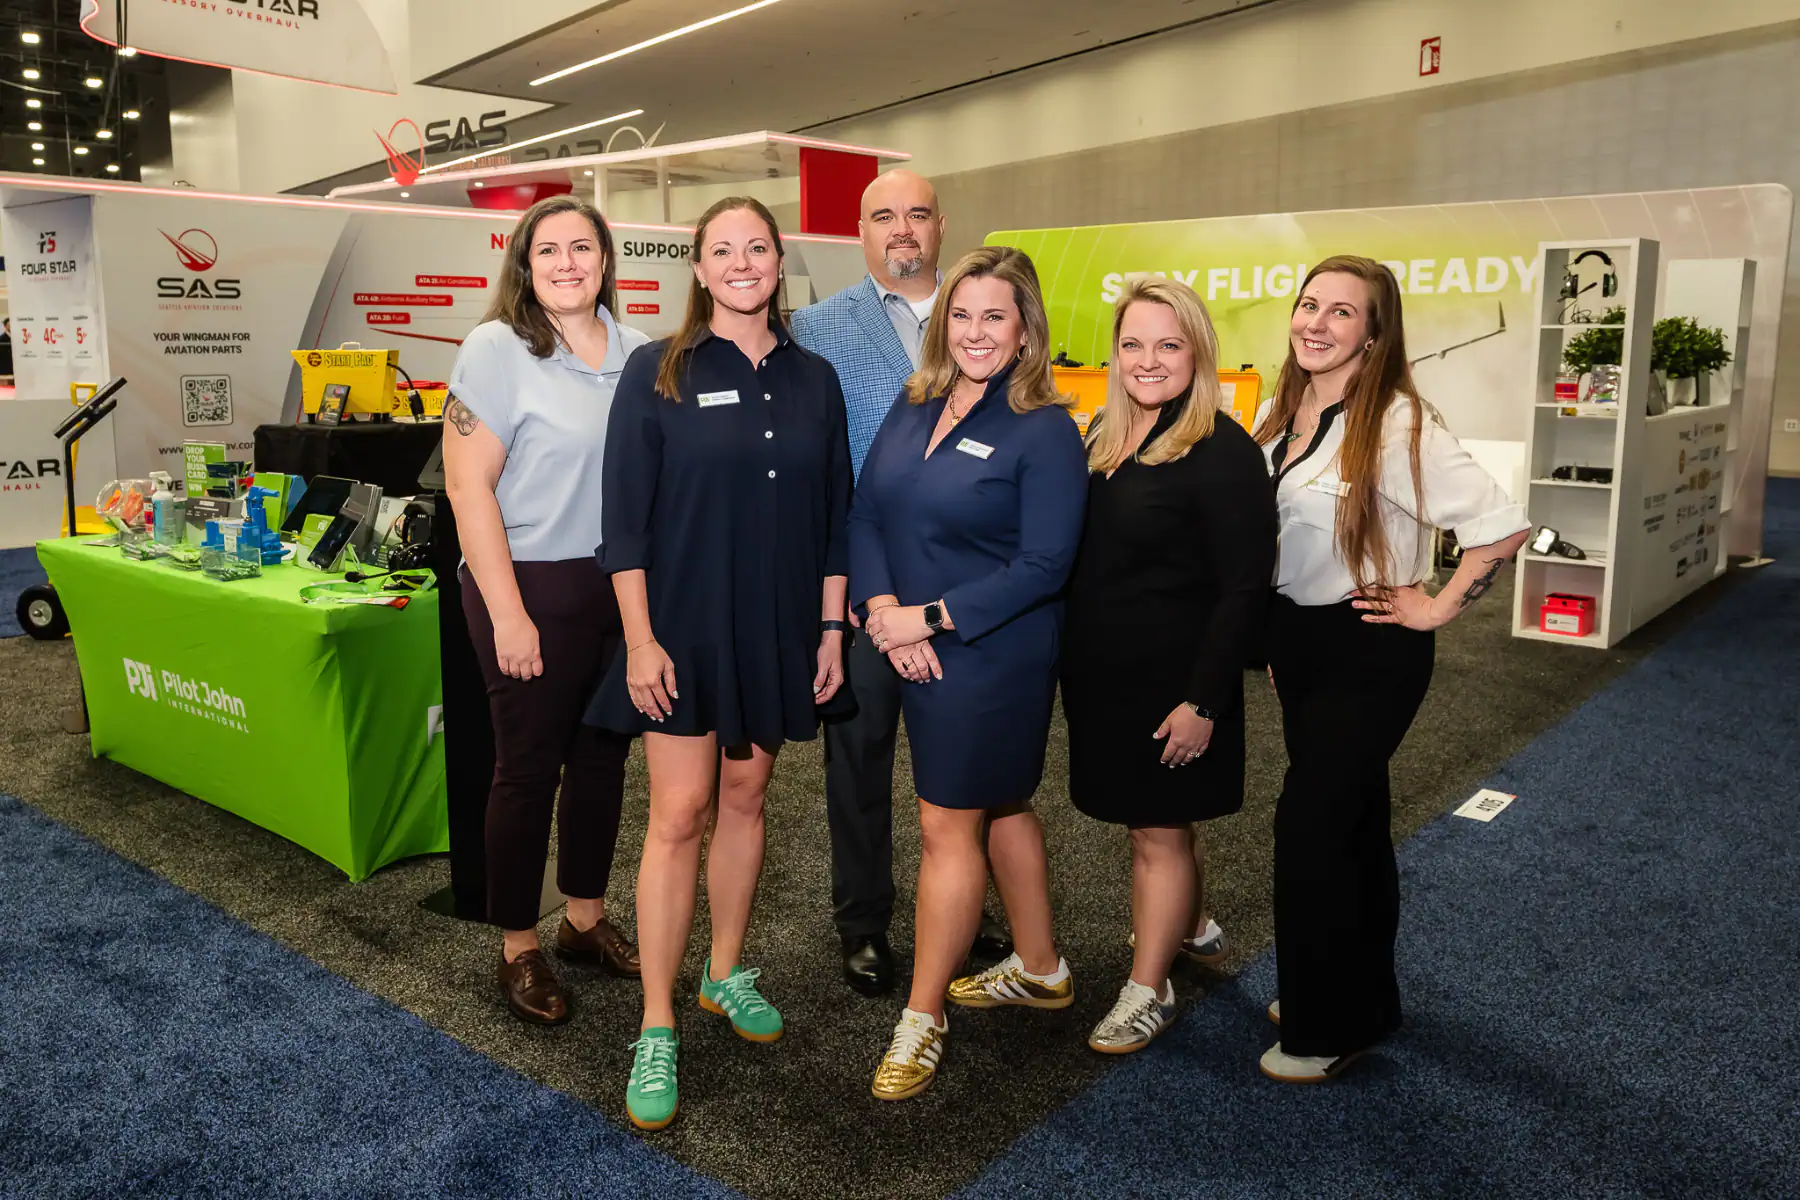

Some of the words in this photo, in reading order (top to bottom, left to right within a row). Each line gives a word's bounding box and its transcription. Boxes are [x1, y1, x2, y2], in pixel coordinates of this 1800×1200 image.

[226, 7, 300, 30] OVERHAUL
[424, 109, 507, 154] SAS
[21, 263, 48, 275] FOUR
[49, 260, 77, 274] STAR
[157, 277, 241, 299] SAS
[153, 332, 181, 342] YOUR
[182, 332, 231, 342] WINGMAN
[232, 332, 251, 341] FOR
[164, 345, 210, 355] AVIATION
[211, 345, 242, 354] PARTS
[185, 446, 205, 455] DROP
[187, 471, 207, 479] CARD
[161, 669, 201, 703] Pilot
[200, 681, 246, 718] John
[167, 697, 249, 734] INTERNATIONAL
